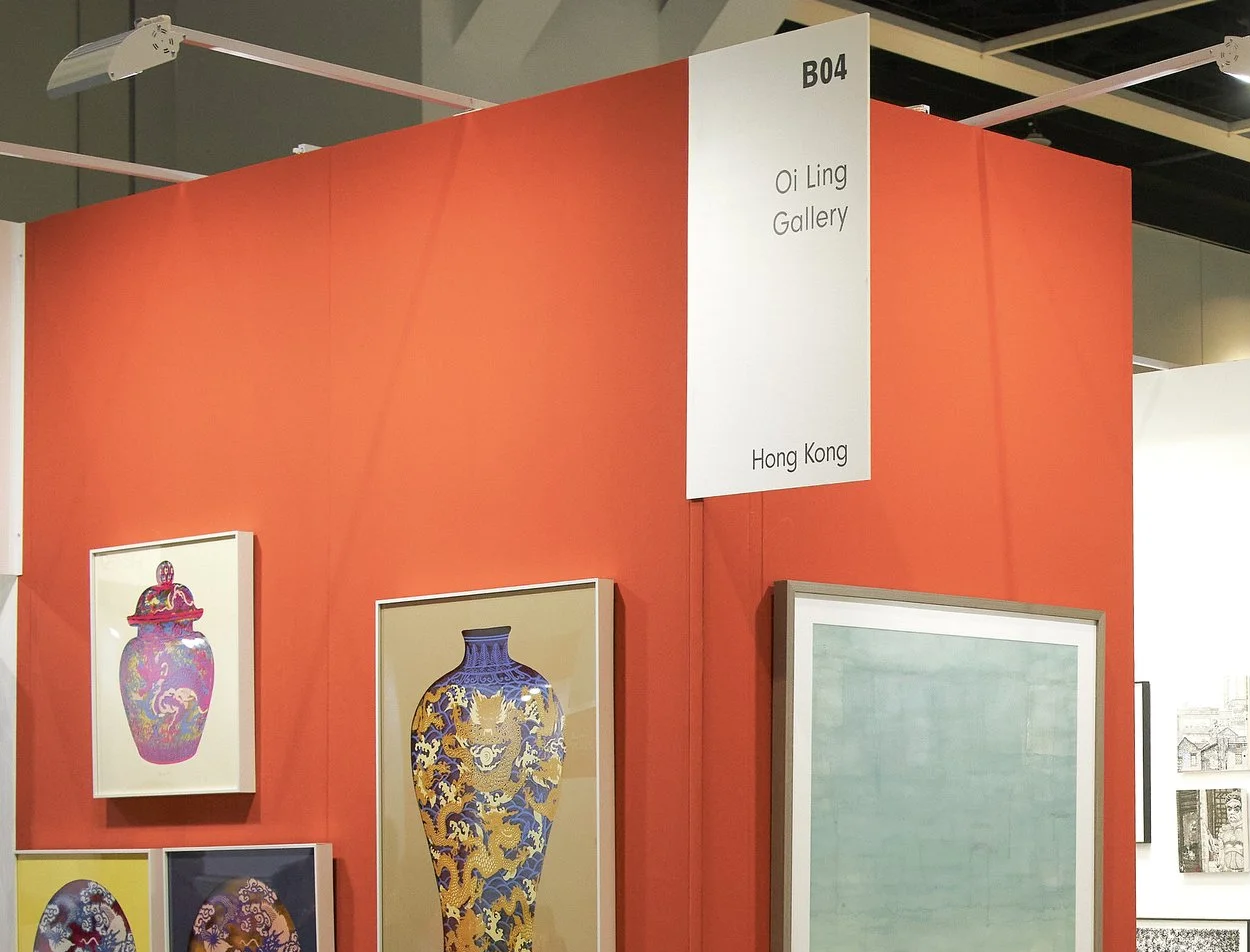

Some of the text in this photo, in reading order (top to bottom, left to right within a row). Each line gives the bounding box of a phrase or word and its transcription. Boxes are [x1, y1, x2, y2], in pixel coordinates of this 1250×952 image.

[803, 53, 848, 89] B04
[775, 163, 848, 194] Oi Ling
[773, 205, 849, 236] Gallery
[752, 441, 848, 473] Hong Kong
